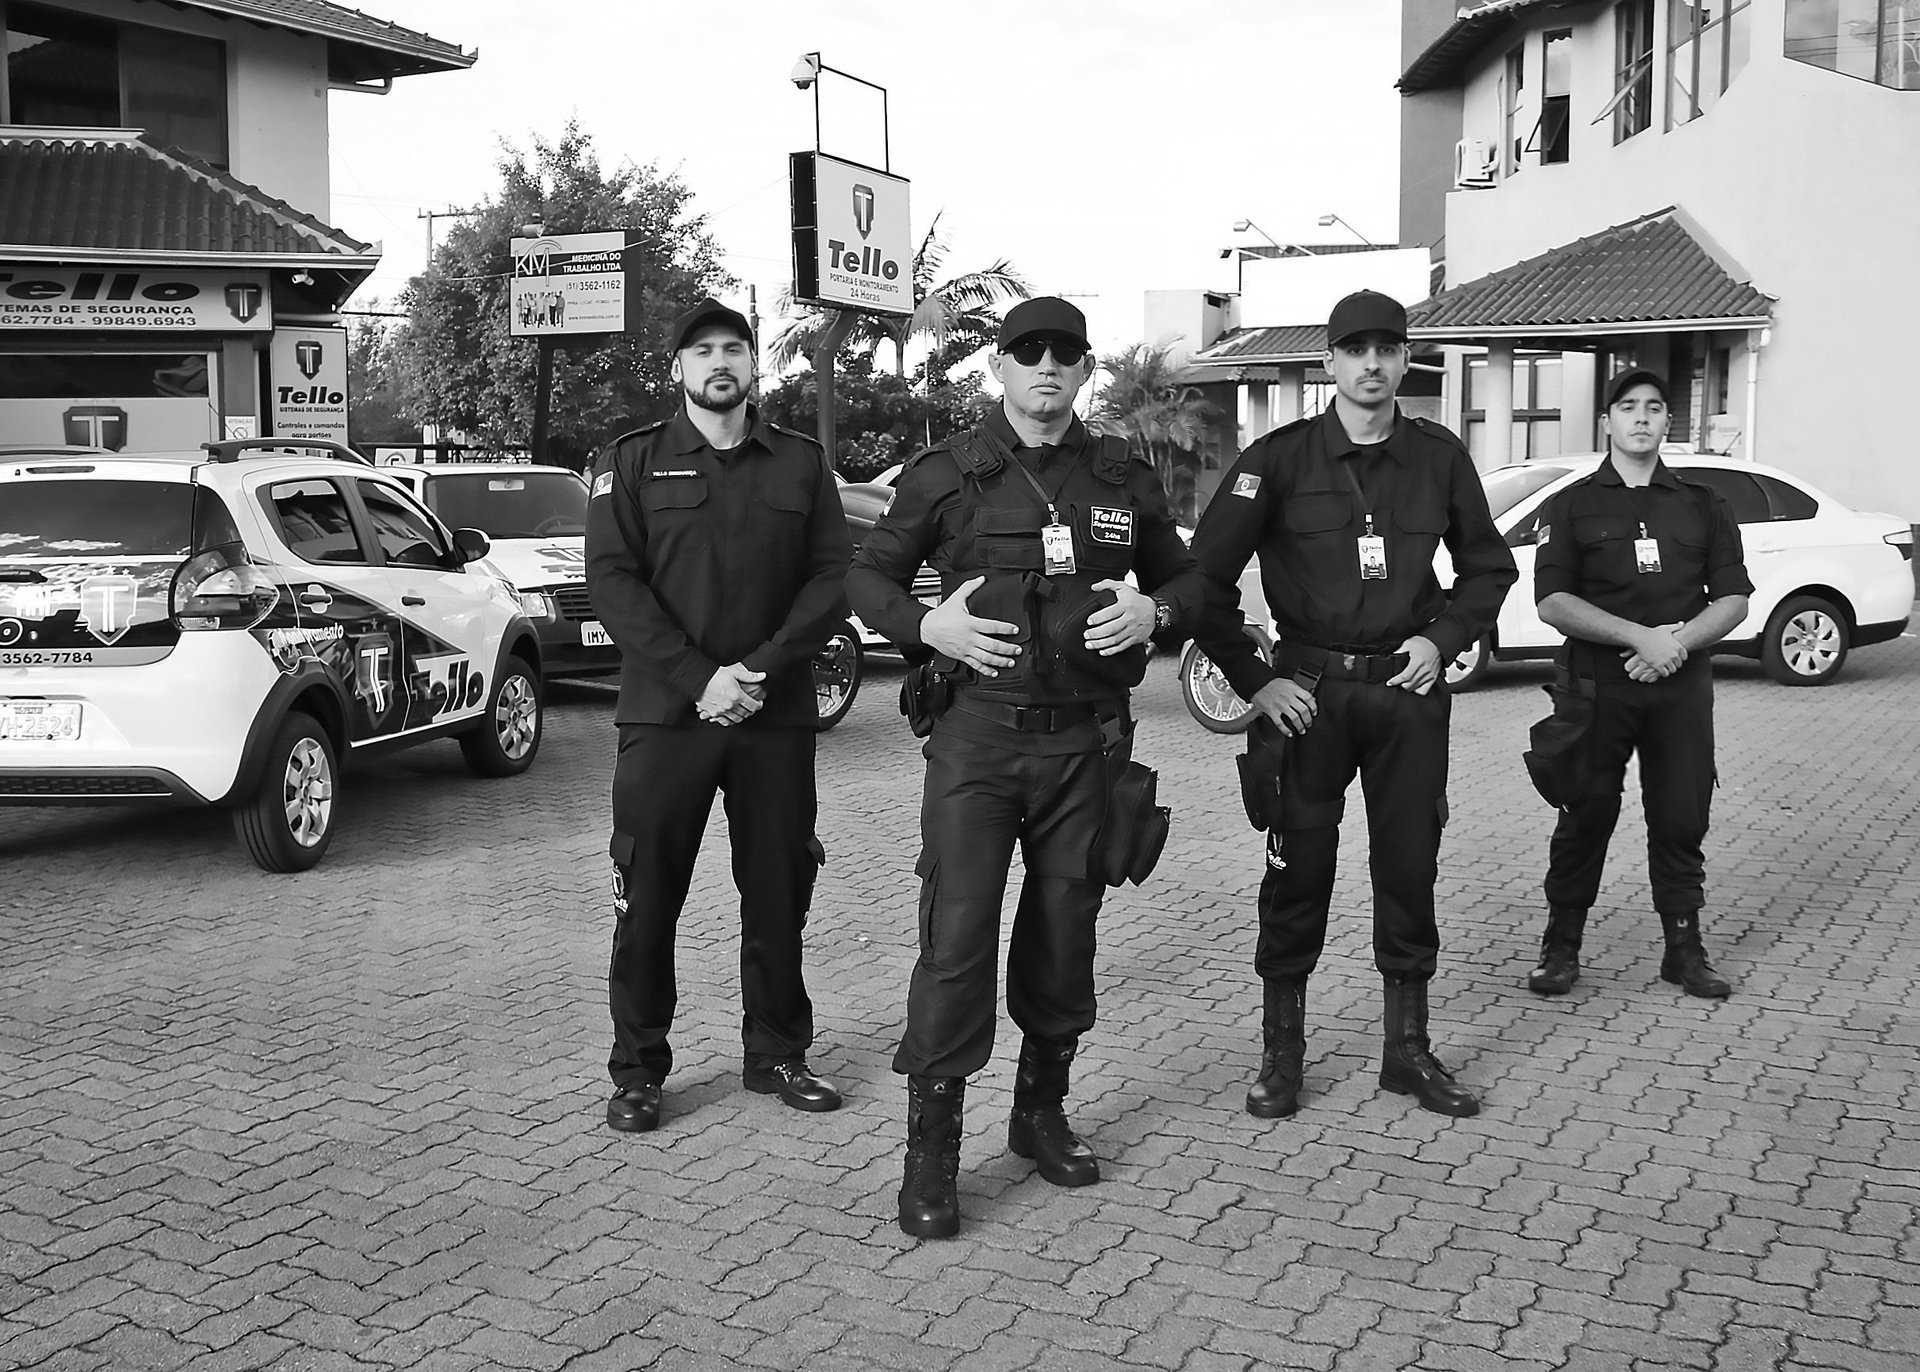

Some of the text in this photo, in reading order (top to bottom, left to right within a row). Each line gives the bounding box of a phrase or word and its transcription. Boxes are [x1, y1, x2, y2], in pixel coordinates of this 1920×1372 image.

[572, 252, 622, 263] MEDICINA DO
[829, 239, 899, 281] Tello
[563, 262, 622, 273] TRABALHO LTDA
[0, 273, 200, 302] ello
[579, 280, 621, 291] 3562-1162
[829, 273, 854, 285] PORTARIA
[859, 279, 899, 293] MONITORAMENTO
[850, 287, 881, 302] 24 Horas
[59, 304, 82, 314] DE
[87, 305, 194, 315] SEGURANÇA
[1, 315, 74, 325] 62.7784
[91, 316, 196, 326] 99849.6943
[277, 386, 344, 405] Tello
[277, 421, 306, 429] Controles
[1093, 510, 1130, 524] Tello
[2, 652, 93, 665] 3562-7784
